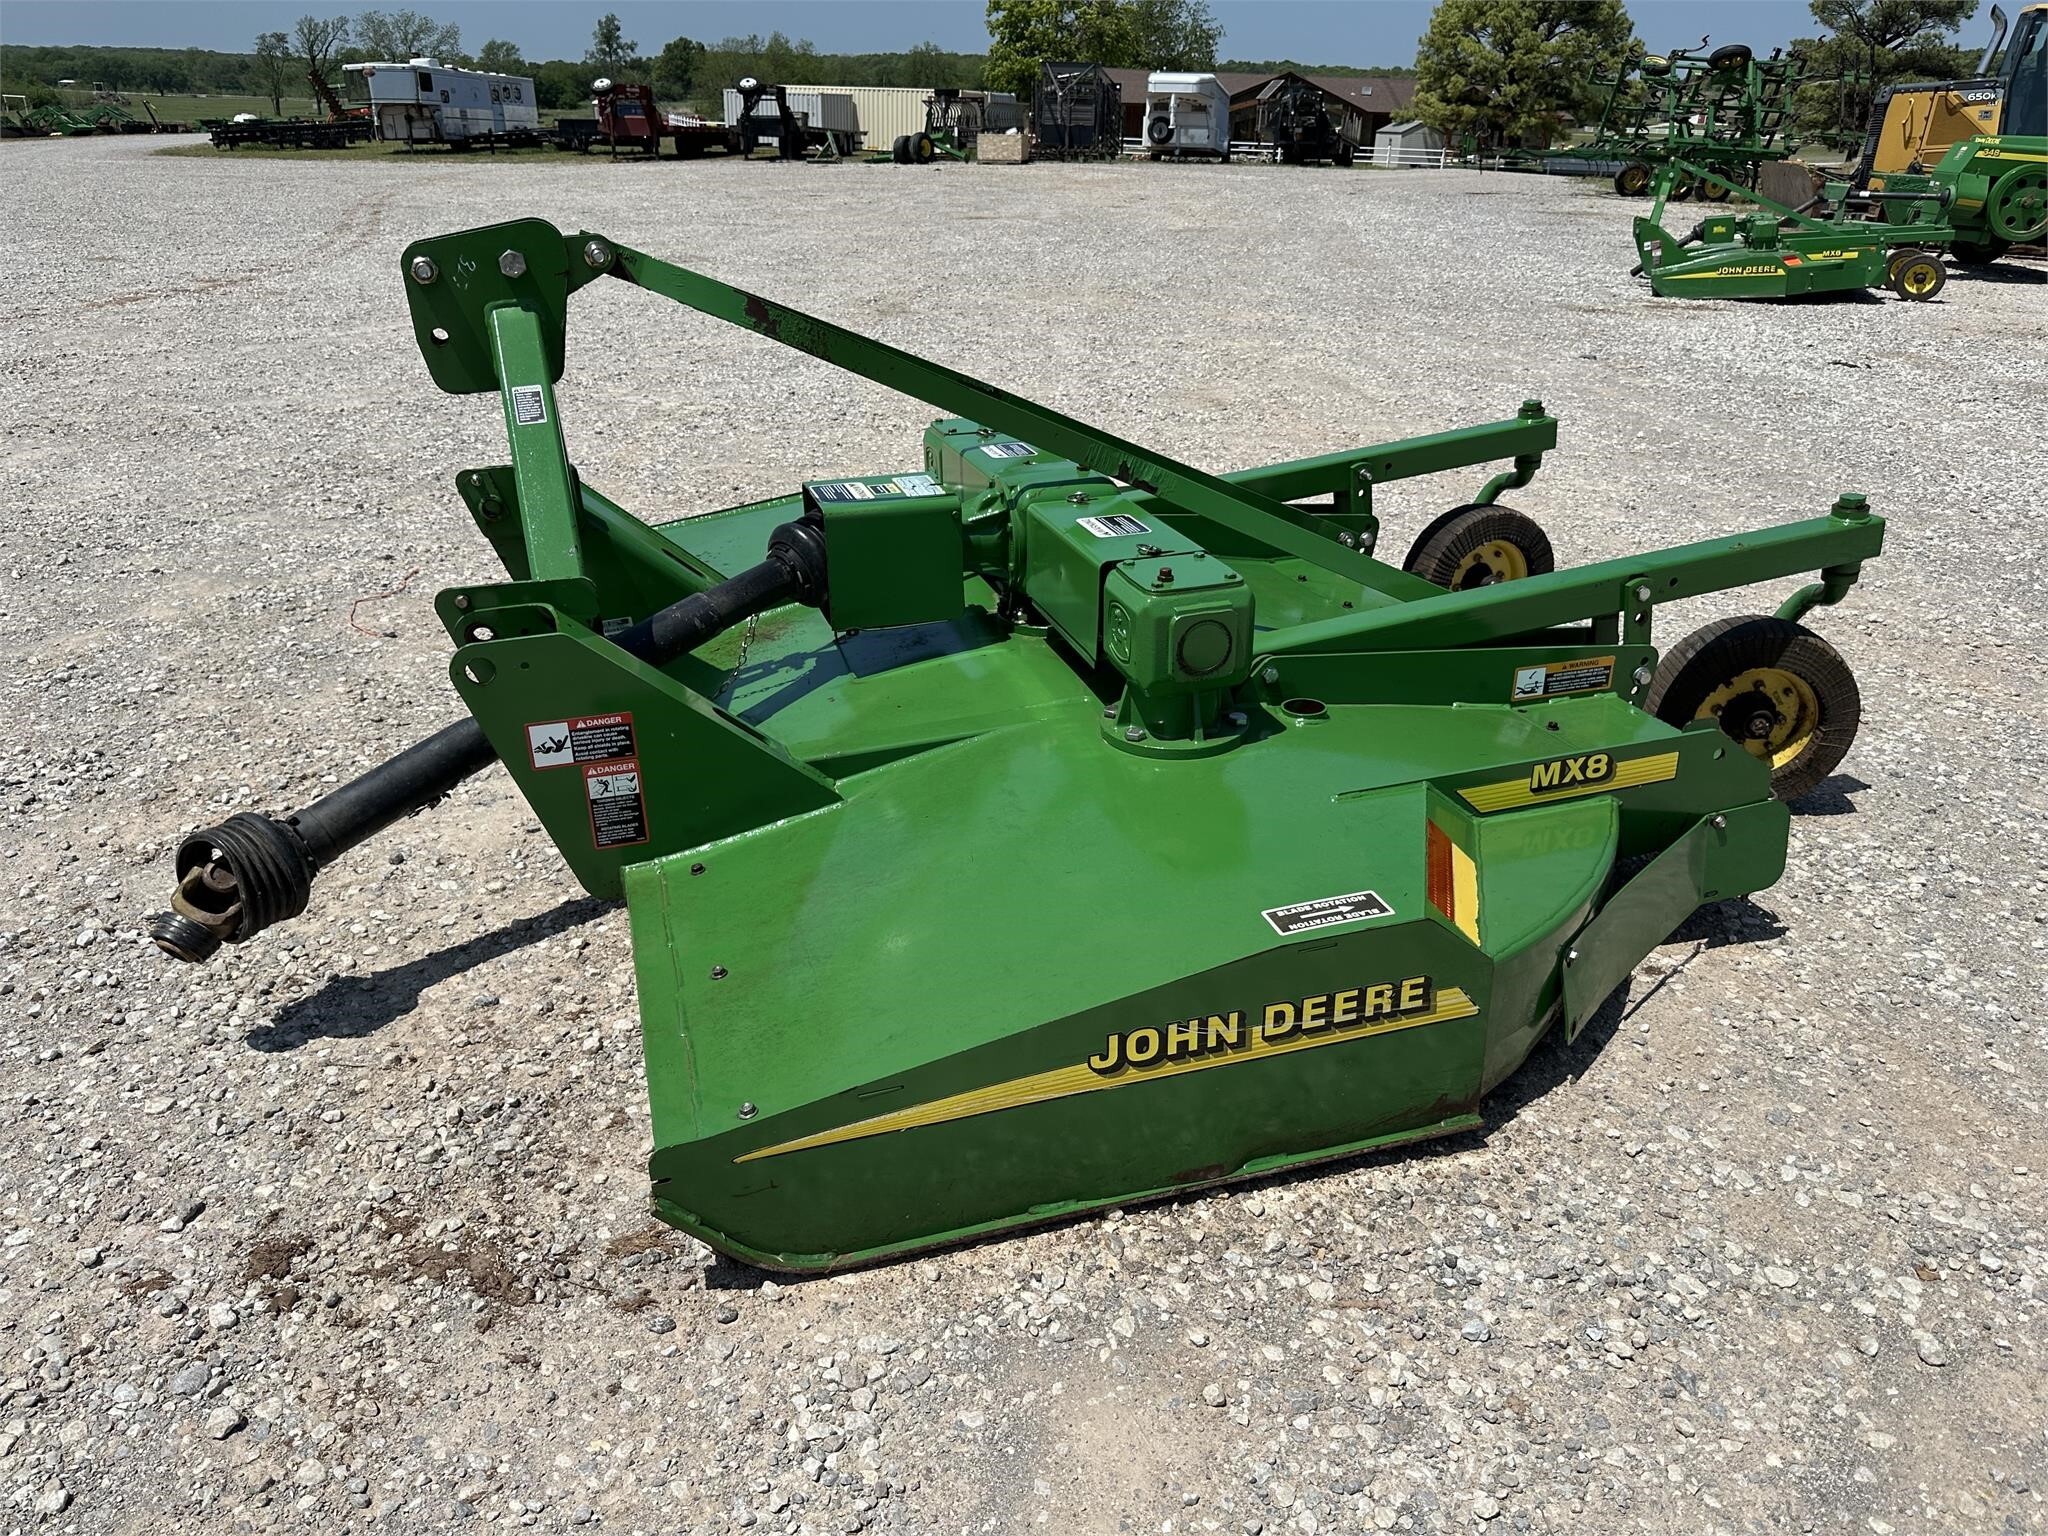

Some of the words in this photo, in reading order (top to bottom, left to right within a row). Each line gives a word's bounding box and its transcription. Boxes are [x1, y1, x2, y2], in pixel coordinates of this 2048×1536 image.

[1983, 148, 2000, 157] 348
[1717, 266, 1742, 274] JOHN
[1745, 265, 1776, 273] DEERE
[1569, 659, 1599, 669] WARNING
[586, 716, 622, 727] DANGER
[597, 762, 635, 774] DANGER
[1531, 753, 1610, 790] MX8
[1276, 905, 1312, 917] BLADE
[1313, 895, 1367, 909] ROTATION
[1345, 908, 1381, 920] BLADE
[1288, 914, 1343, 930] ROTATION
[1088, 1011, 1241, 1071] JOHN
[1262, 975, 1428, 1039] DEERE
